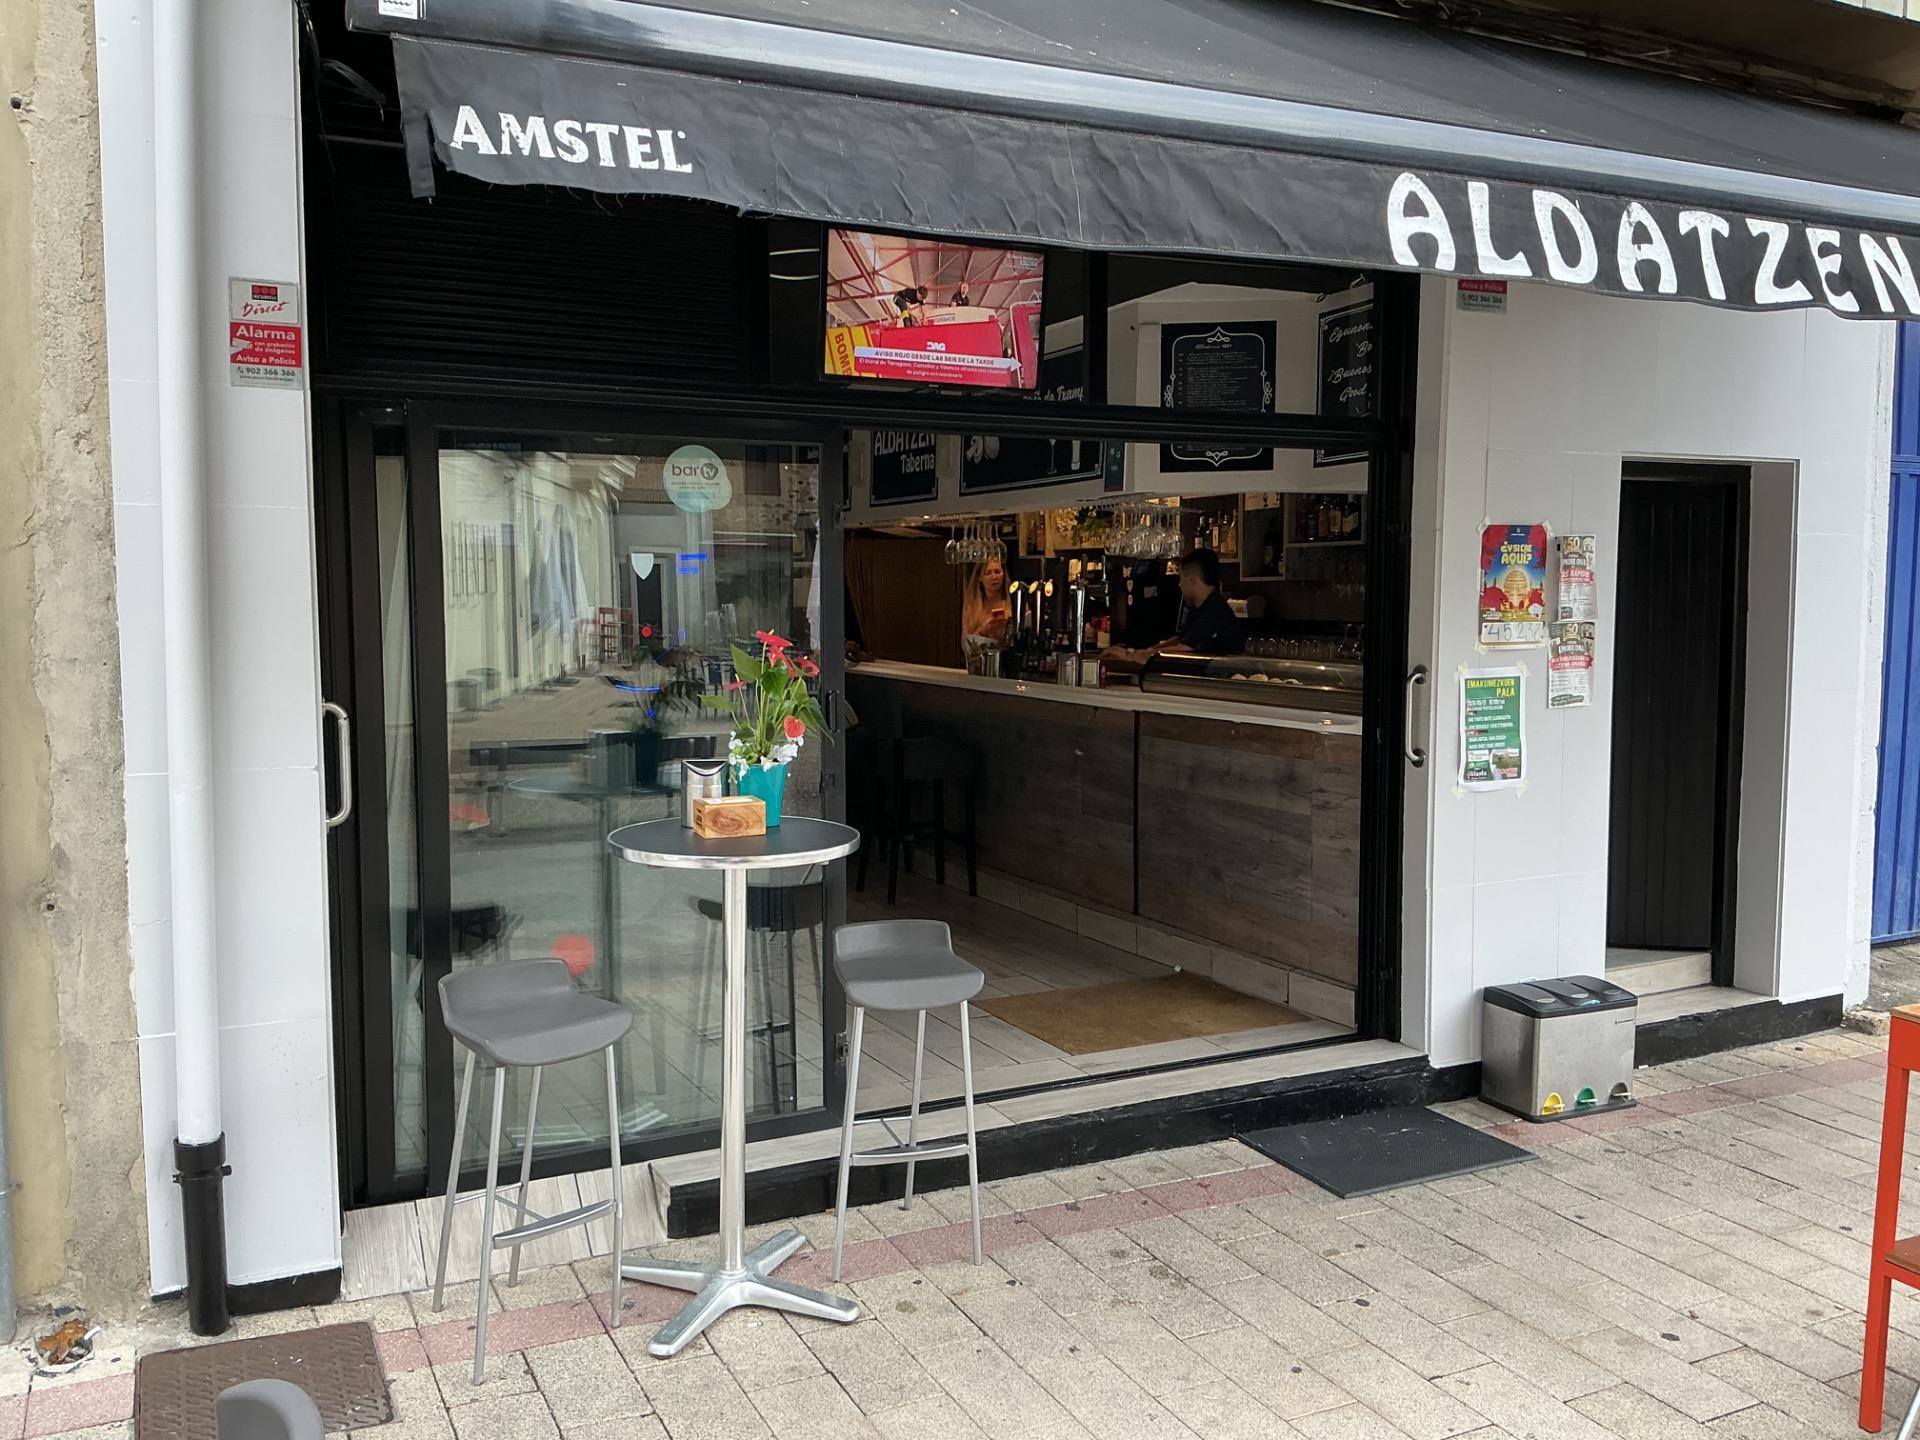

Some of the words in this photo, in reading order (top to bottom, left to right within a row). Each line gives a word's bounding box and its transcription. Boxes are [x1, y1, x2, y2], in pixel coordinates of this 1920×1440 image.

[450, 105, 692, 173] AMSTEL
[1387, 172, 1920, 313] ALDATZEN
[236, 325, 295, 340] Alarma
[236, 354, 259, 363] Aviso
[895, 351, 910, 359] ROJO
[911, 352, 931, 360] DESDE
[958, 355, 966, 363] DE
[967, 356, 975, 364] LA
[246, 367, 260, 375] 902
[901, 453, 935, 474] Taberna
[1497, 687, 1514, 697] PALA
